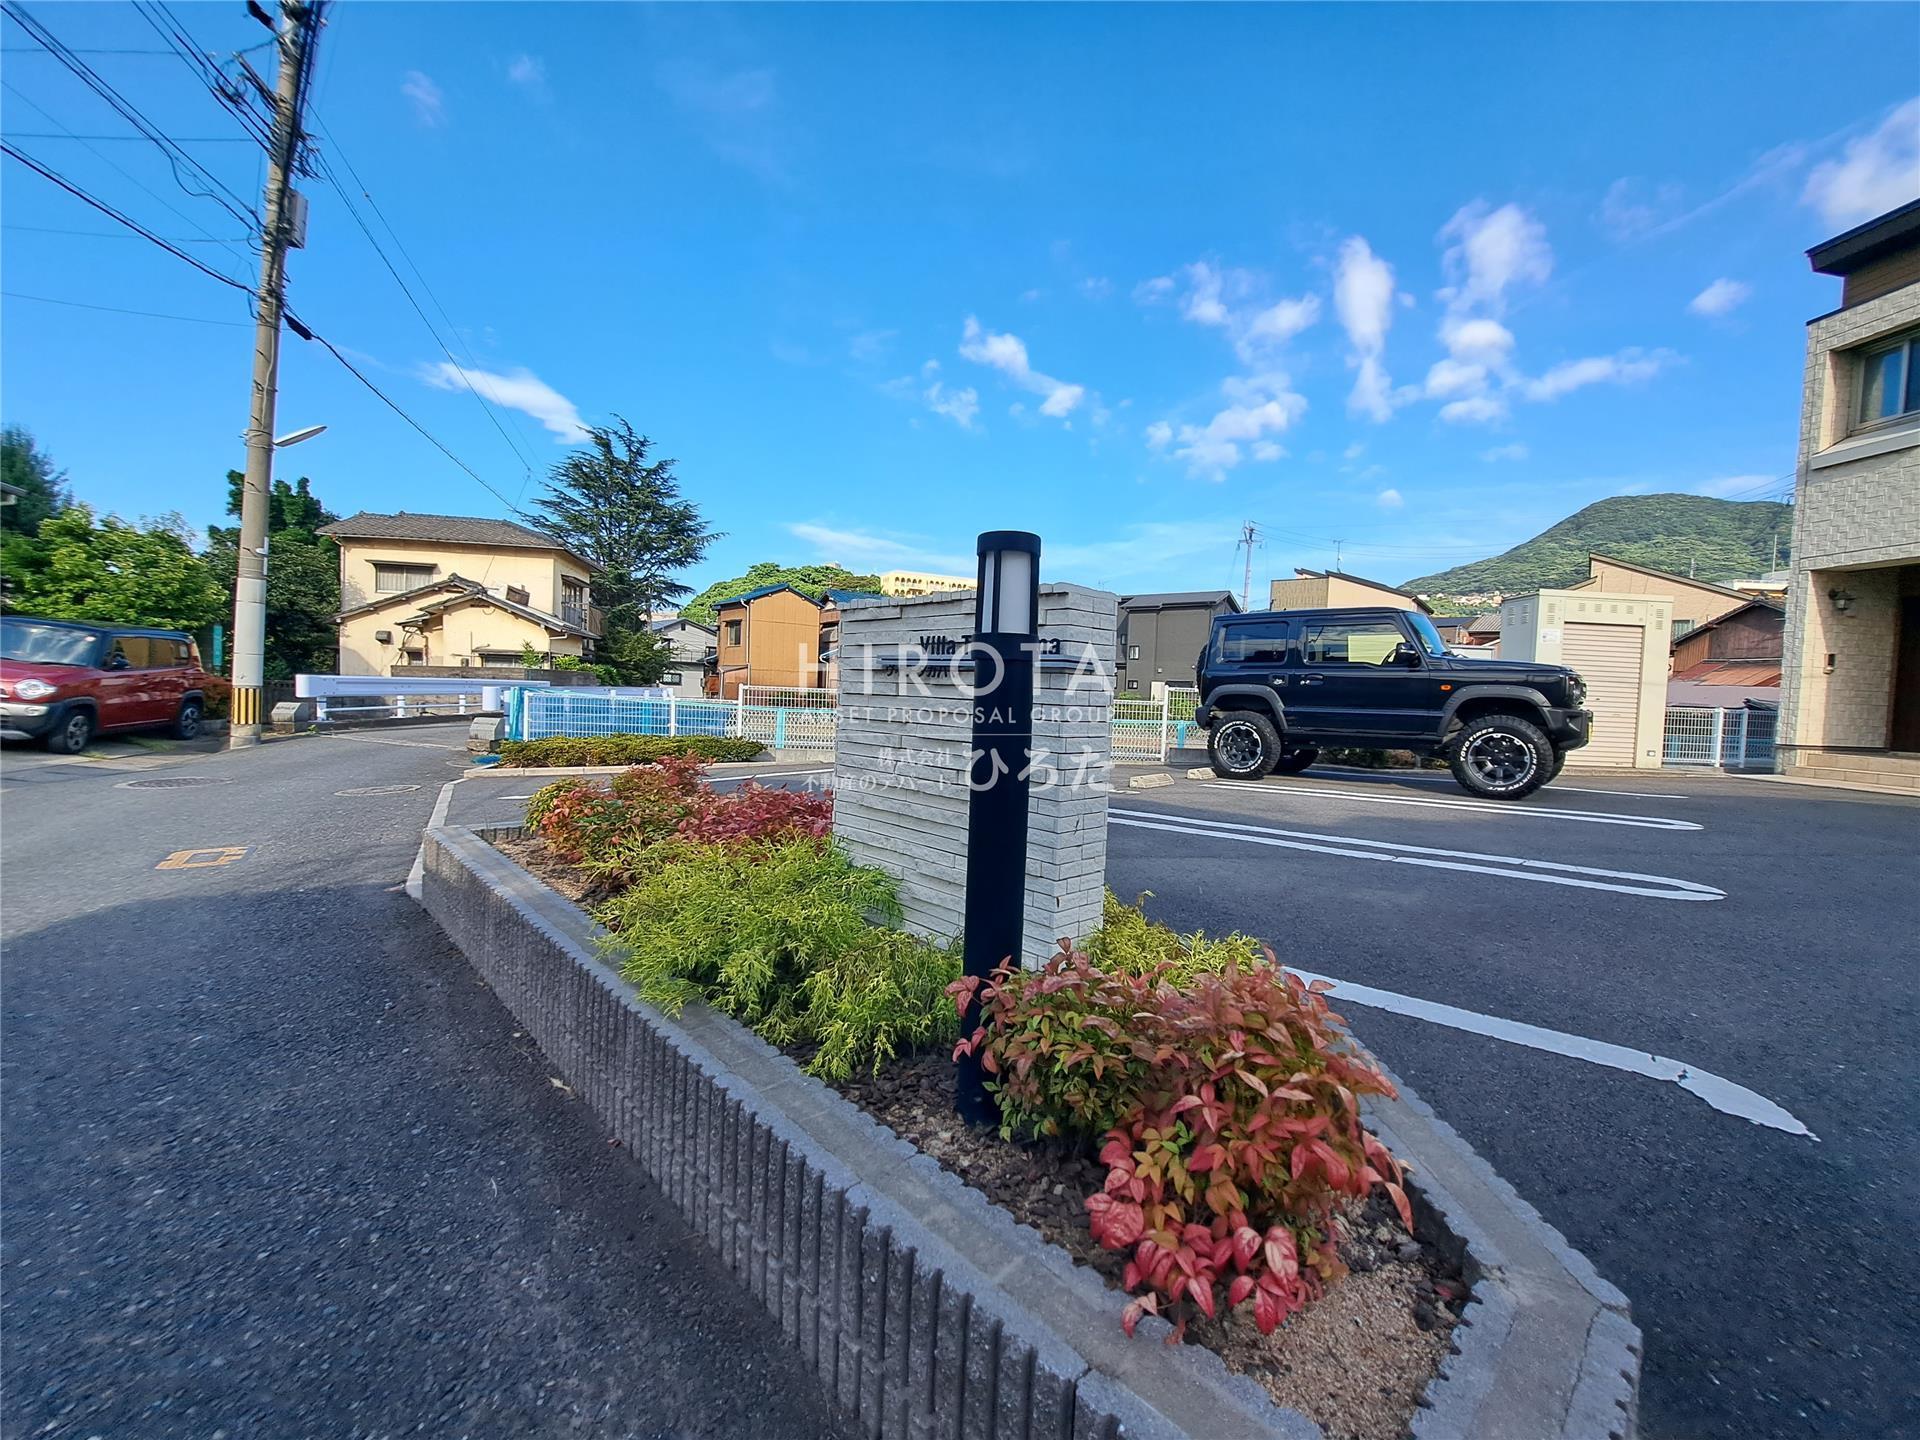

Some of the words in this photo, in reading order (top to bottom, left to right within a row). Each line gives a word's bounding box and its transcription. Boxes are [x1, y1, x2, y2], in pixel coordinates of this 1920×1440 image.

[920, 635, 957, 656] Villa
[1460, 740, 1471, 761] TOYO
[1469, 727, 1495, 742] TIRES
[1528, 743, 1537, 764] OPEN
